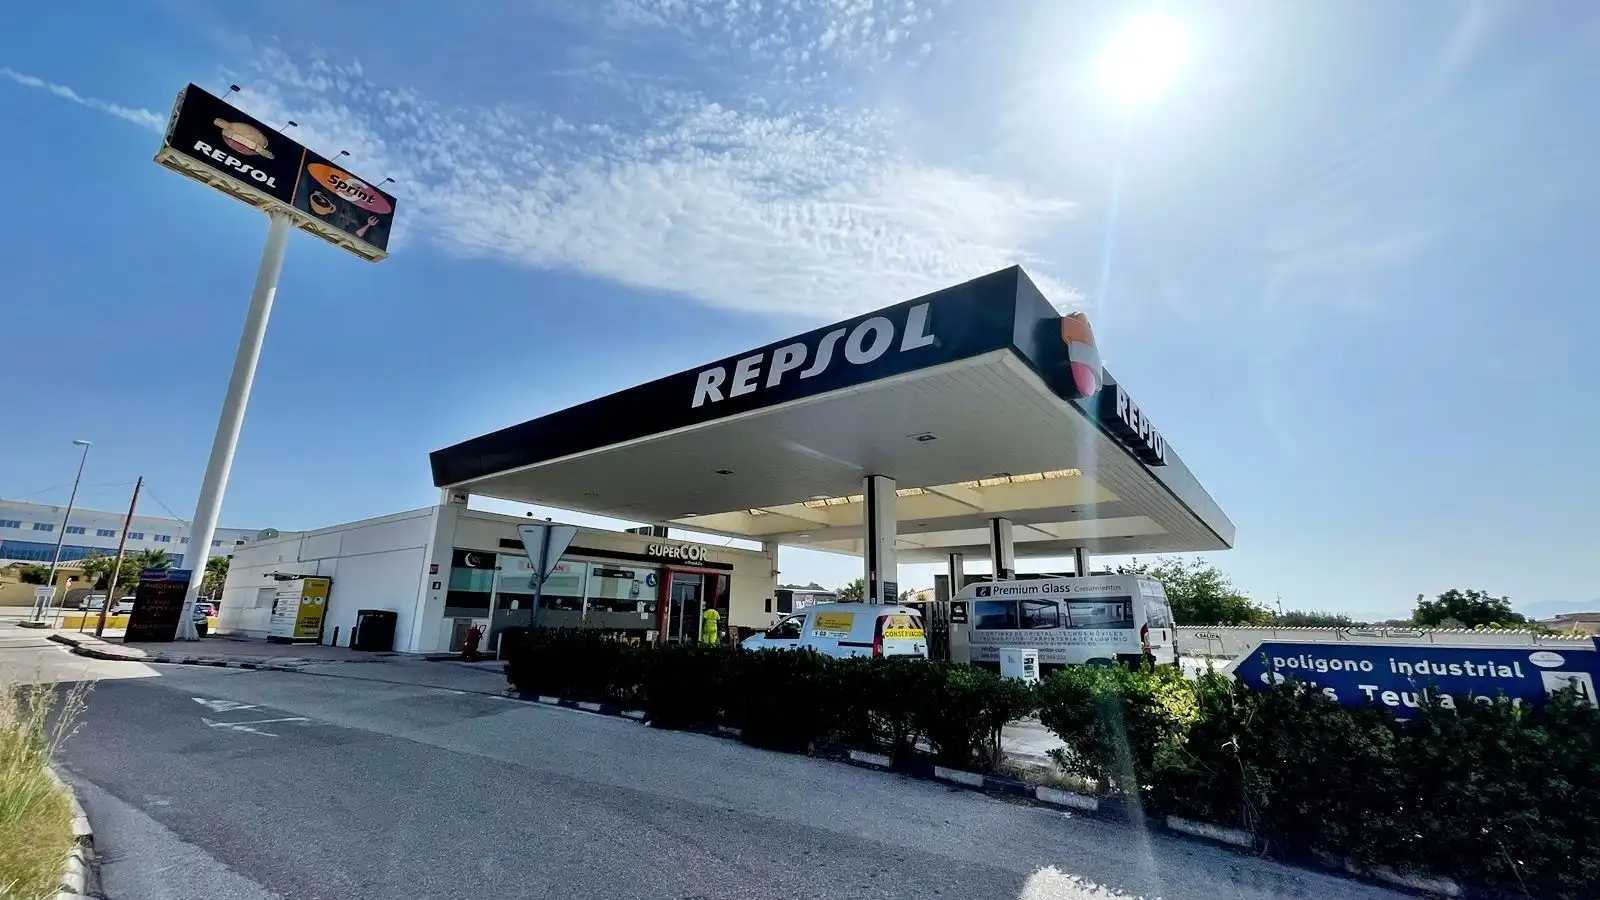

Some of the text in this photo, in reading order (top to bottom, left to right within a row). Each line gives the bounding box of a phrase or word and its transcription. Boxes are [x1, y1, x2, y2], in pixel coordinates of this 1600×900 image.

[193, 140, 277, 188] REPSOL
[327, 174, 376, 205] Sprint
[691, 302, 936, 409] REPSOL
[1116, 384, 1168, 466] REPSOL
[648, 543, 708, 561] SUPERCOR
[993, 586, 1039, 595] Premium
[1041, 583, 1070, 593] Glass
[1273, 654, 1525, 678] polígono industrial
